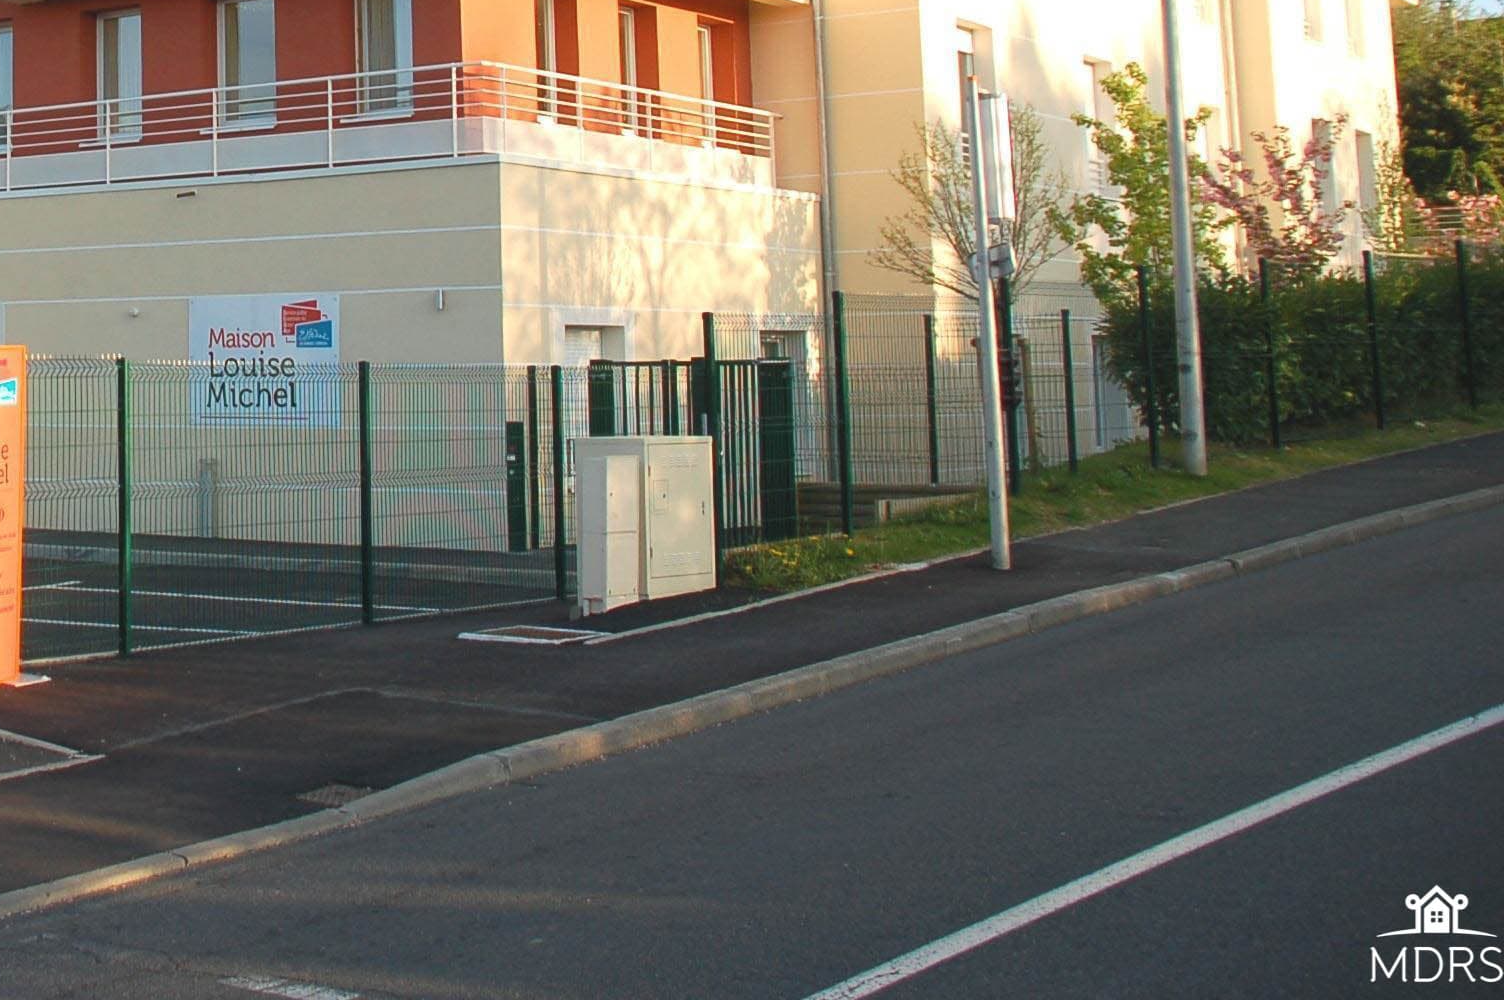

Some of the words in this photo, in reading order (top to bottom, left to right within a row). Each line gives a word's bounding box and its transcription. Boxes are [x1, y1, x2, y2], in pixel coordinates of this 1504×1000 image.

[208, 328, 275, 348] Maison
[208, 351, 295, 378] Louise
[206, 381, 296, 408] Michel
